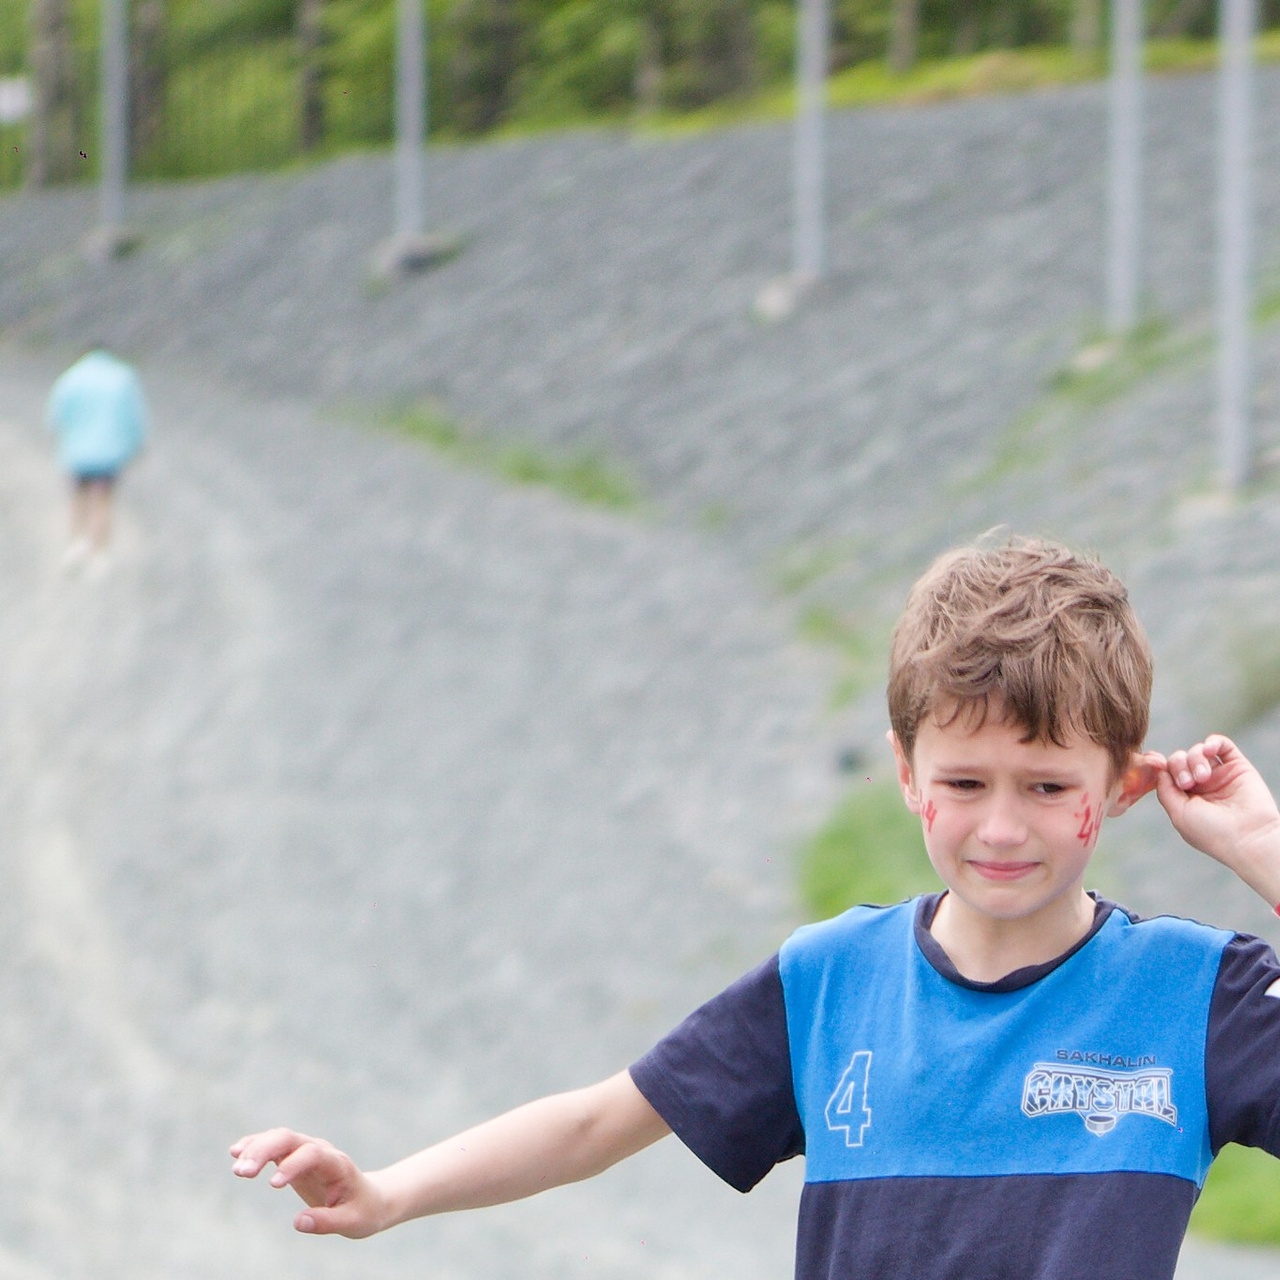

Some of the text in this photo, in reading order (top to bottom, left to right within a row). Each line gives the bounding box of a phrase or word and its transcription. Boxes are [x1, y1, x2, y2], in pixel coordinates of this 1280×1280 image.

[1056, 1050, 1156, 1067] SAKHALIN
[825, 1051, 873, 1147] 4
[1022, 1070, 1177, 1124] CRYSTAL
